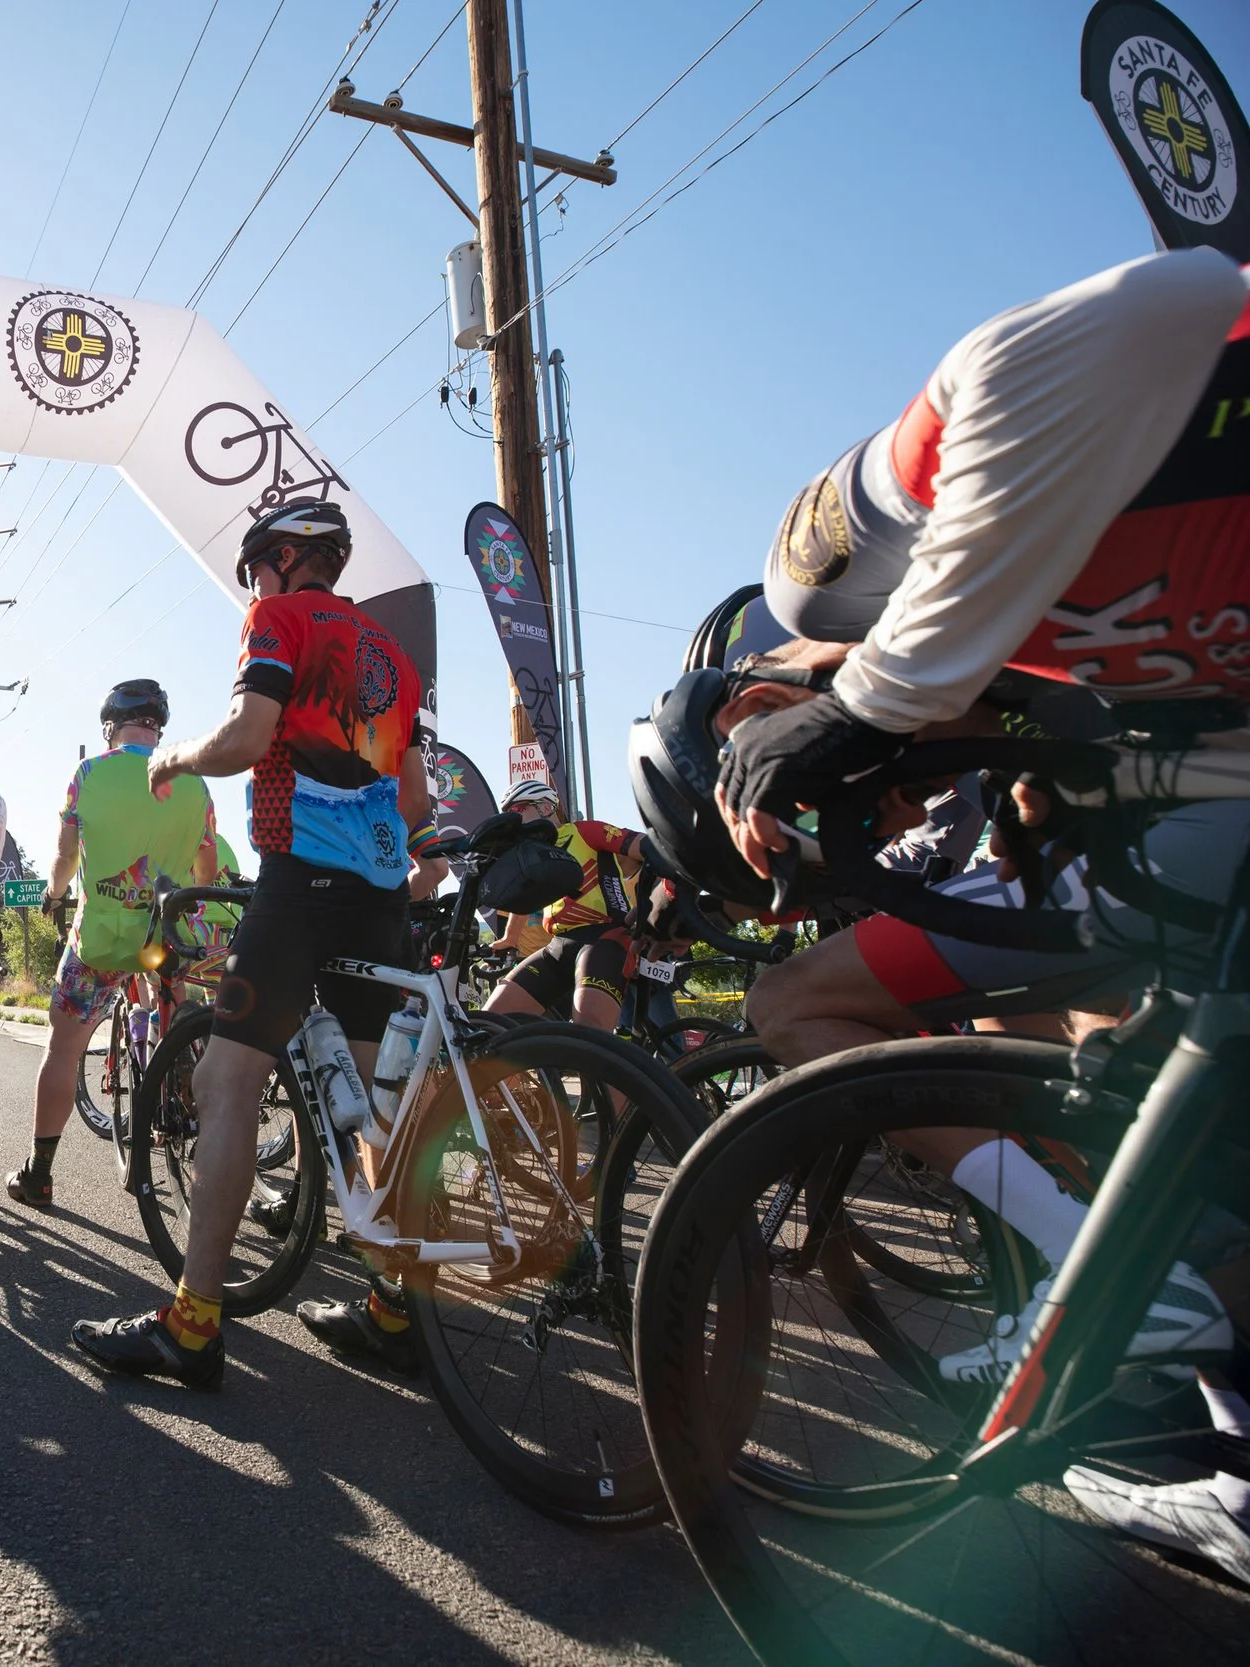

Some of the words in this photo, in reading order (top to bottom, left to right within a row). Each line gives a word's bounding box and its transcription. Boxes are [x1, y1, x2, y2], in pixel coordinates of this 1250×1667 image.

[1117, 40, 1180, 80] SANTA
[1185, 69, 1214, 111] FE
[1146, 163, 1227, 220] CENTURY
[310, 611, 348, 624] MAUI
[511, 621, 525, 633] NEW
[526, 624, 548, 639] MEXICO
[520, 748, 535, 761] NO
[511, 759, 546, 774] PARKING
[521, 772, 537, 780] ANY
[19, 883, 40, 893] STATE
[612, 876, 628, 913] WILSON
[16, 893, 42, 903] CAPITO
[325, 956, 381, 977] REK
[646, 965, 671, 981] 1079
[482, 1156, 502, 1223] TREK
[760, 1182, 791, 1241] IKEWORKS
